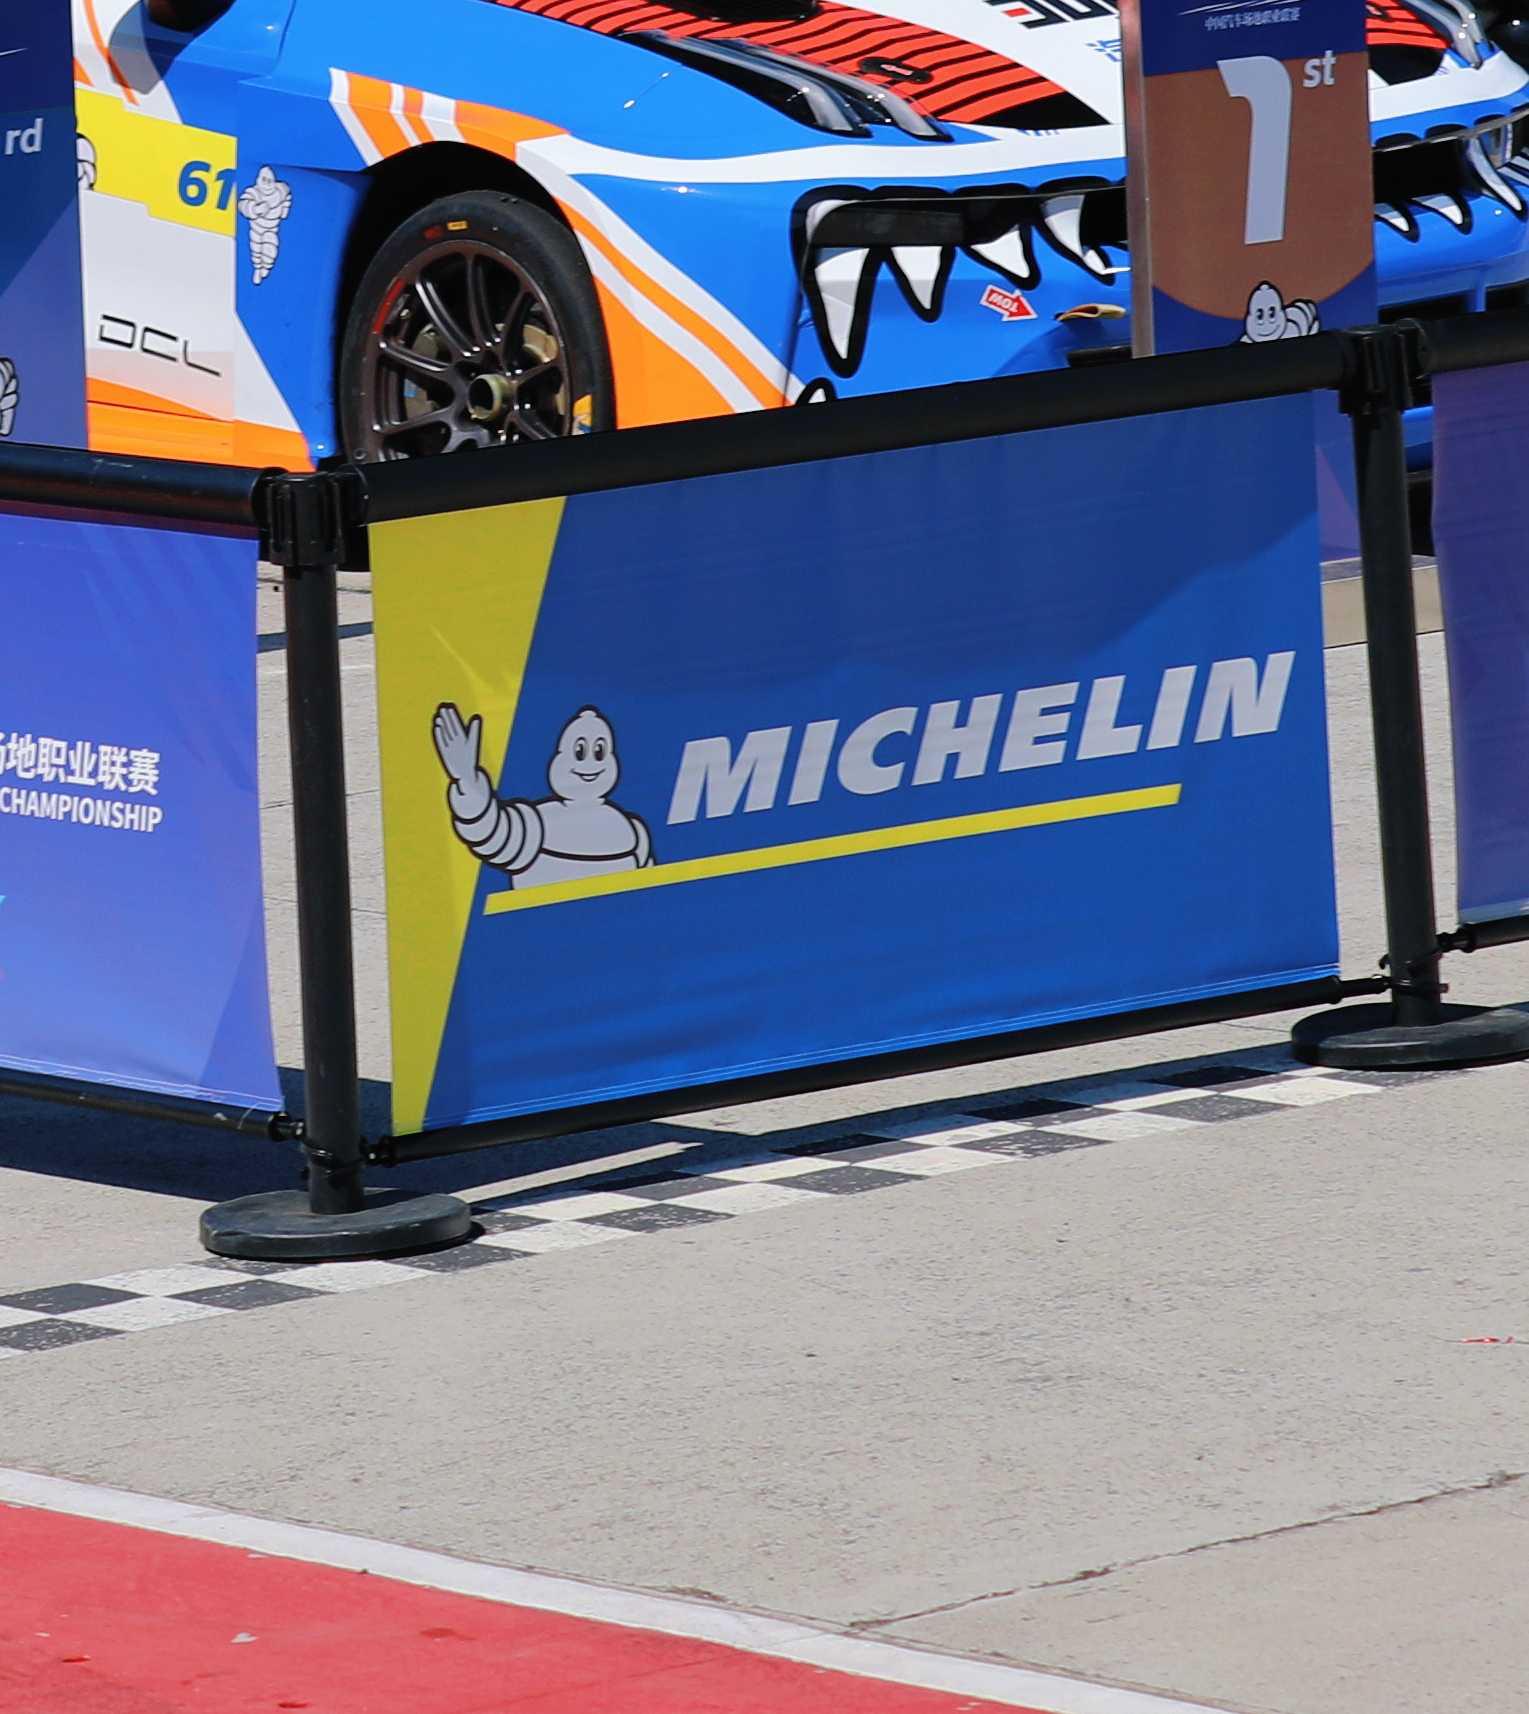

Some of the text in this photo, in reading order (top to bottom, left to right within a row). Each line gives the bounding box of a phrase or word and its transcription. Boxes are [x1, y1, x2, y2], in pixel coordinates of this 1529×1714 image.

[1217, 51, 1337, 245] 1st
[177, 160, 237, 212] 61
[988, 292, 1020, 313] TOW
[98, 314, 222, 377] DCL
[665, 650, 1297, 827] MICHELIN
